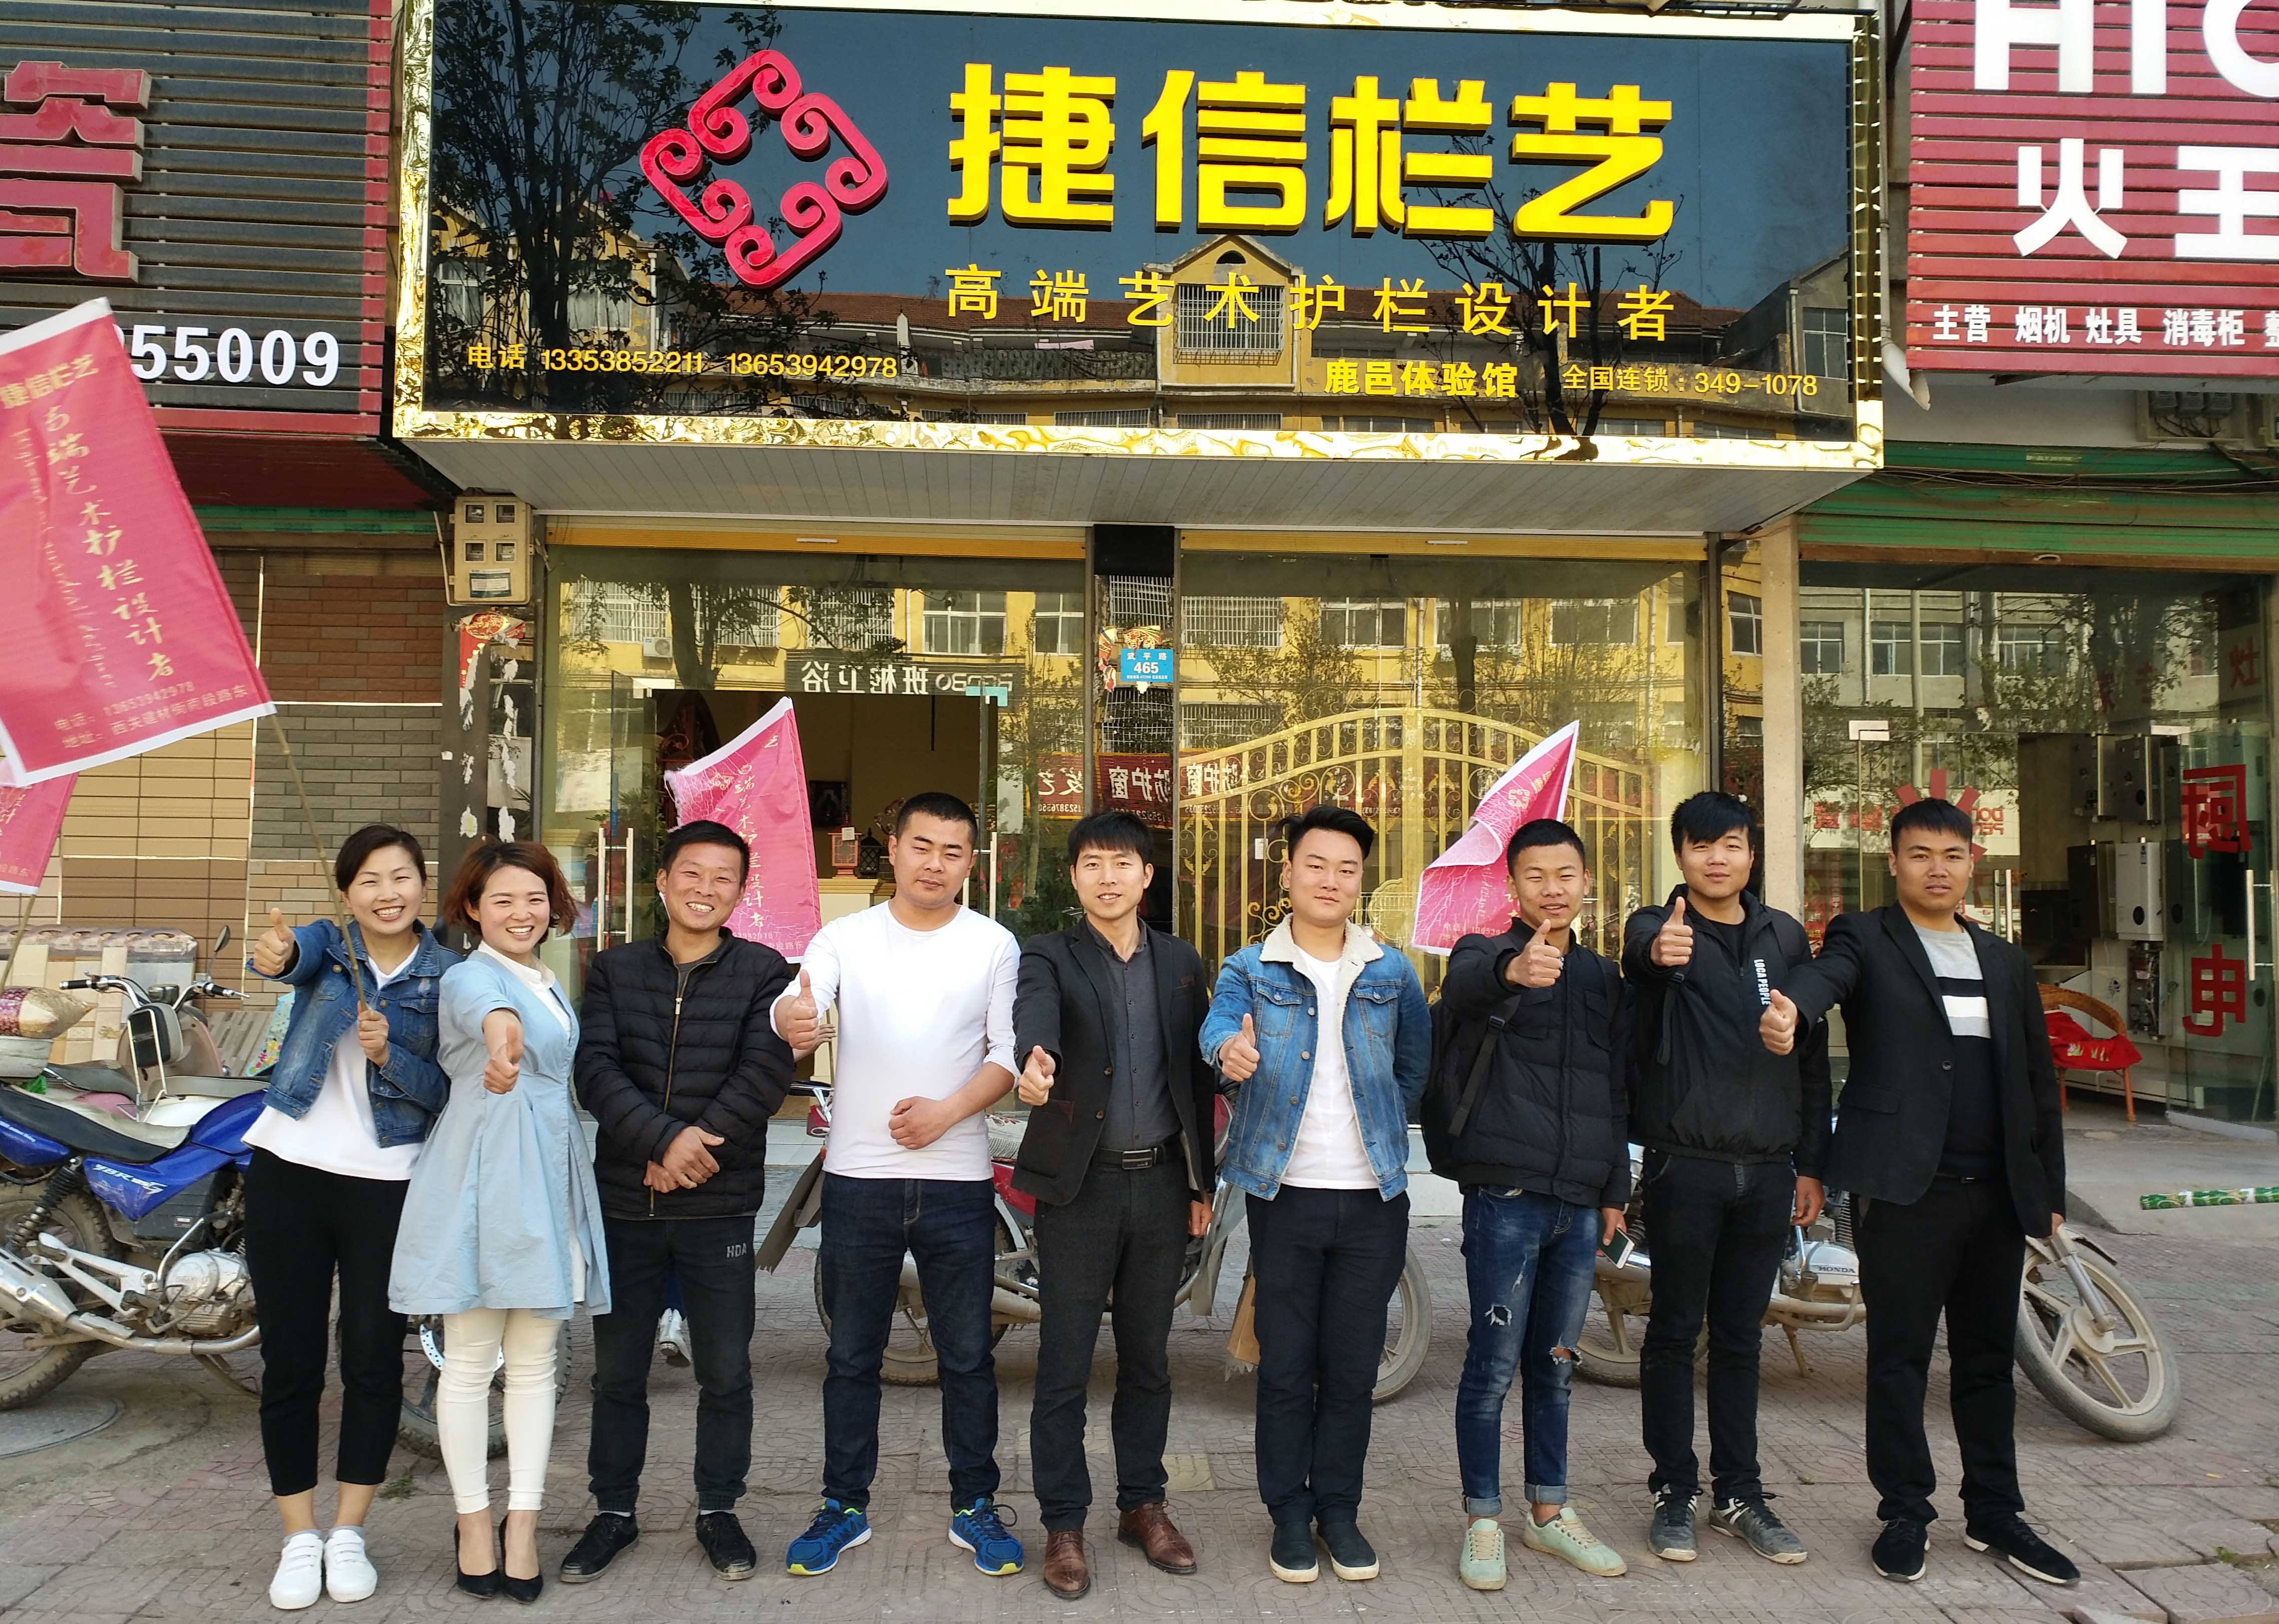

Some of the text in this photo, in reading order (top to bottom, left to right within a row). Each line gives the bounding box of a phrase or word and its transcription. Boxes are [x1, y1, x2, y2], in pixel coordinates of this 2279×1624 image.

[947, 63, 1674, 242] 捷信栏艺
[2013, 138, 2279, 260] 火王
[945, 264, 1675, 341] 高端艺术护栏设计者
[1932, 305, 1991, 344] 主营
[2015, 306, 2070, 345] 烟机
[2085, 307, 2142, 346] 灶具
[2163, 308, 2246, 348] 消毒柜
[114, 324, 340, 387] 55009
[467, 343, 897, 379] 电话 13353852211 13653942978
[1324, 358, 1518, 398] 鹿邑体验馆
[1133, 662, 1159, 674] 465
[1757, 978, 1772, 1005] PEOPLE
[726, 1243, 748, 1259] HDA
[1818, 1266, 1857, 1274] HONDA
